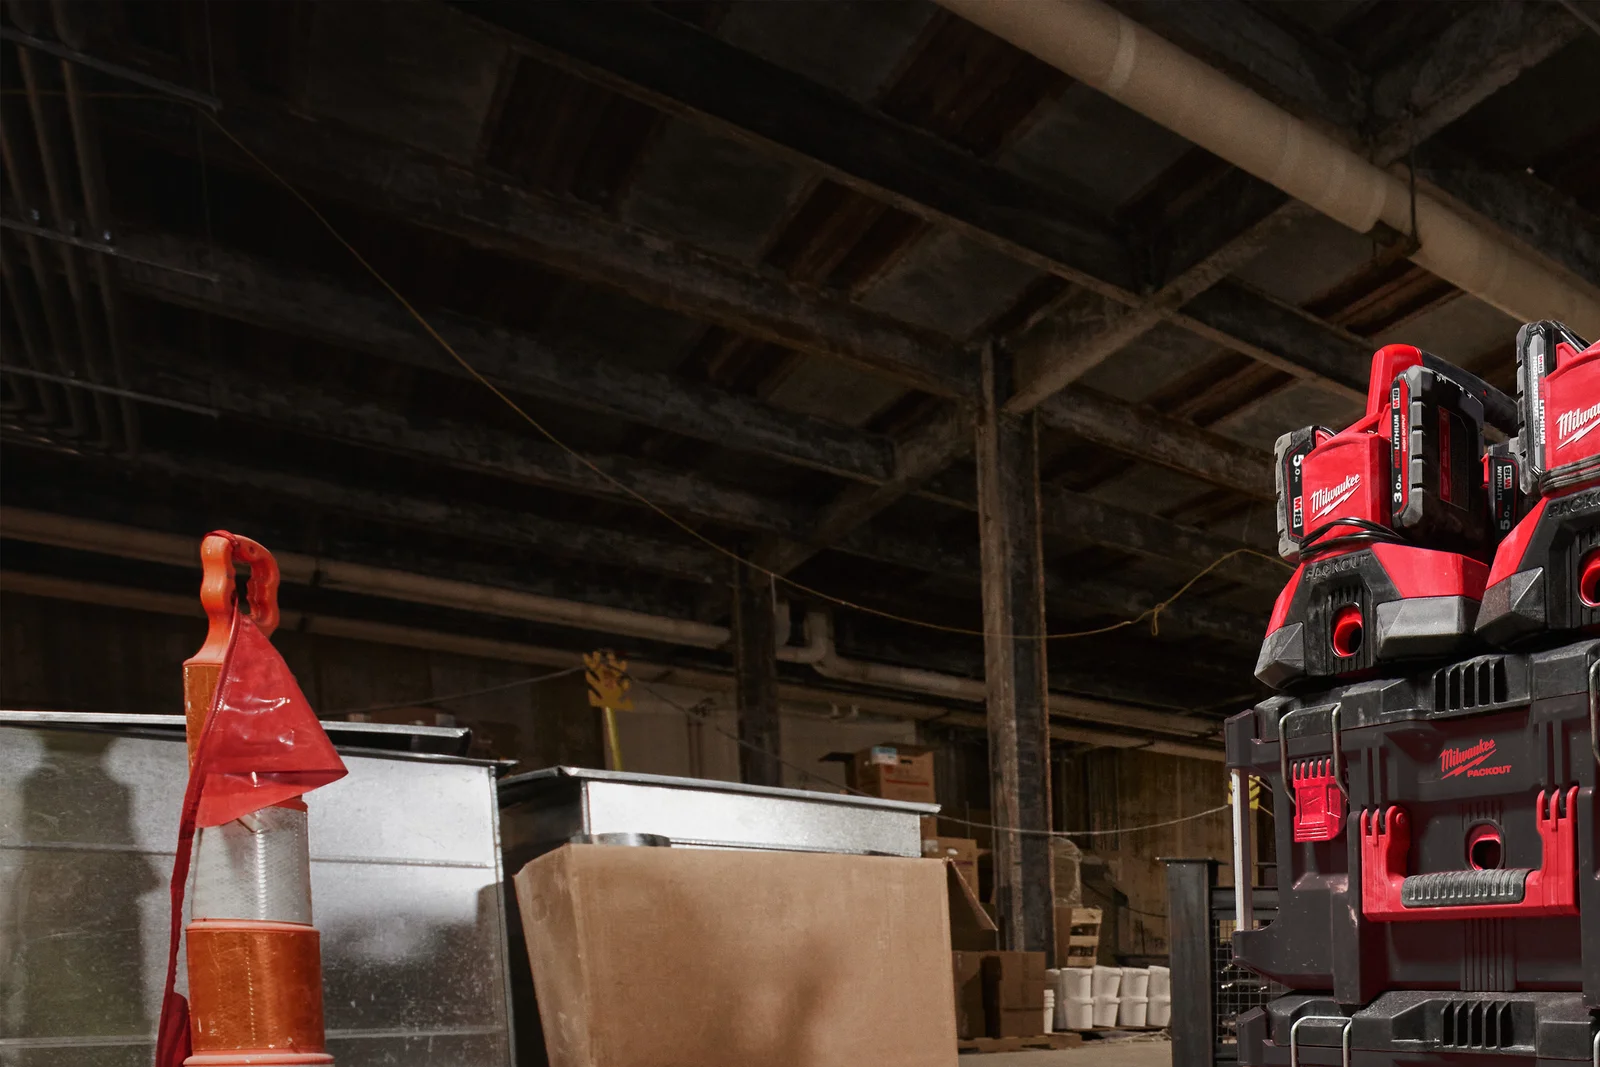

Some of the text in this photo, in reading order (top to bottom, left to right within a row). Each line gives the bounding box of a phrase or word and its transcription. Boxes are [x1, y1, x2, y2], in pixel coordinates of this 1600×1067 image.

[1310, 474, 1360, 513] Milwaukee
[1294, 497, 1302, 527] M18
[1439, 739, 1496, 773] Milwaukee
[1467, 765, 1512, 777] PACKOUT
